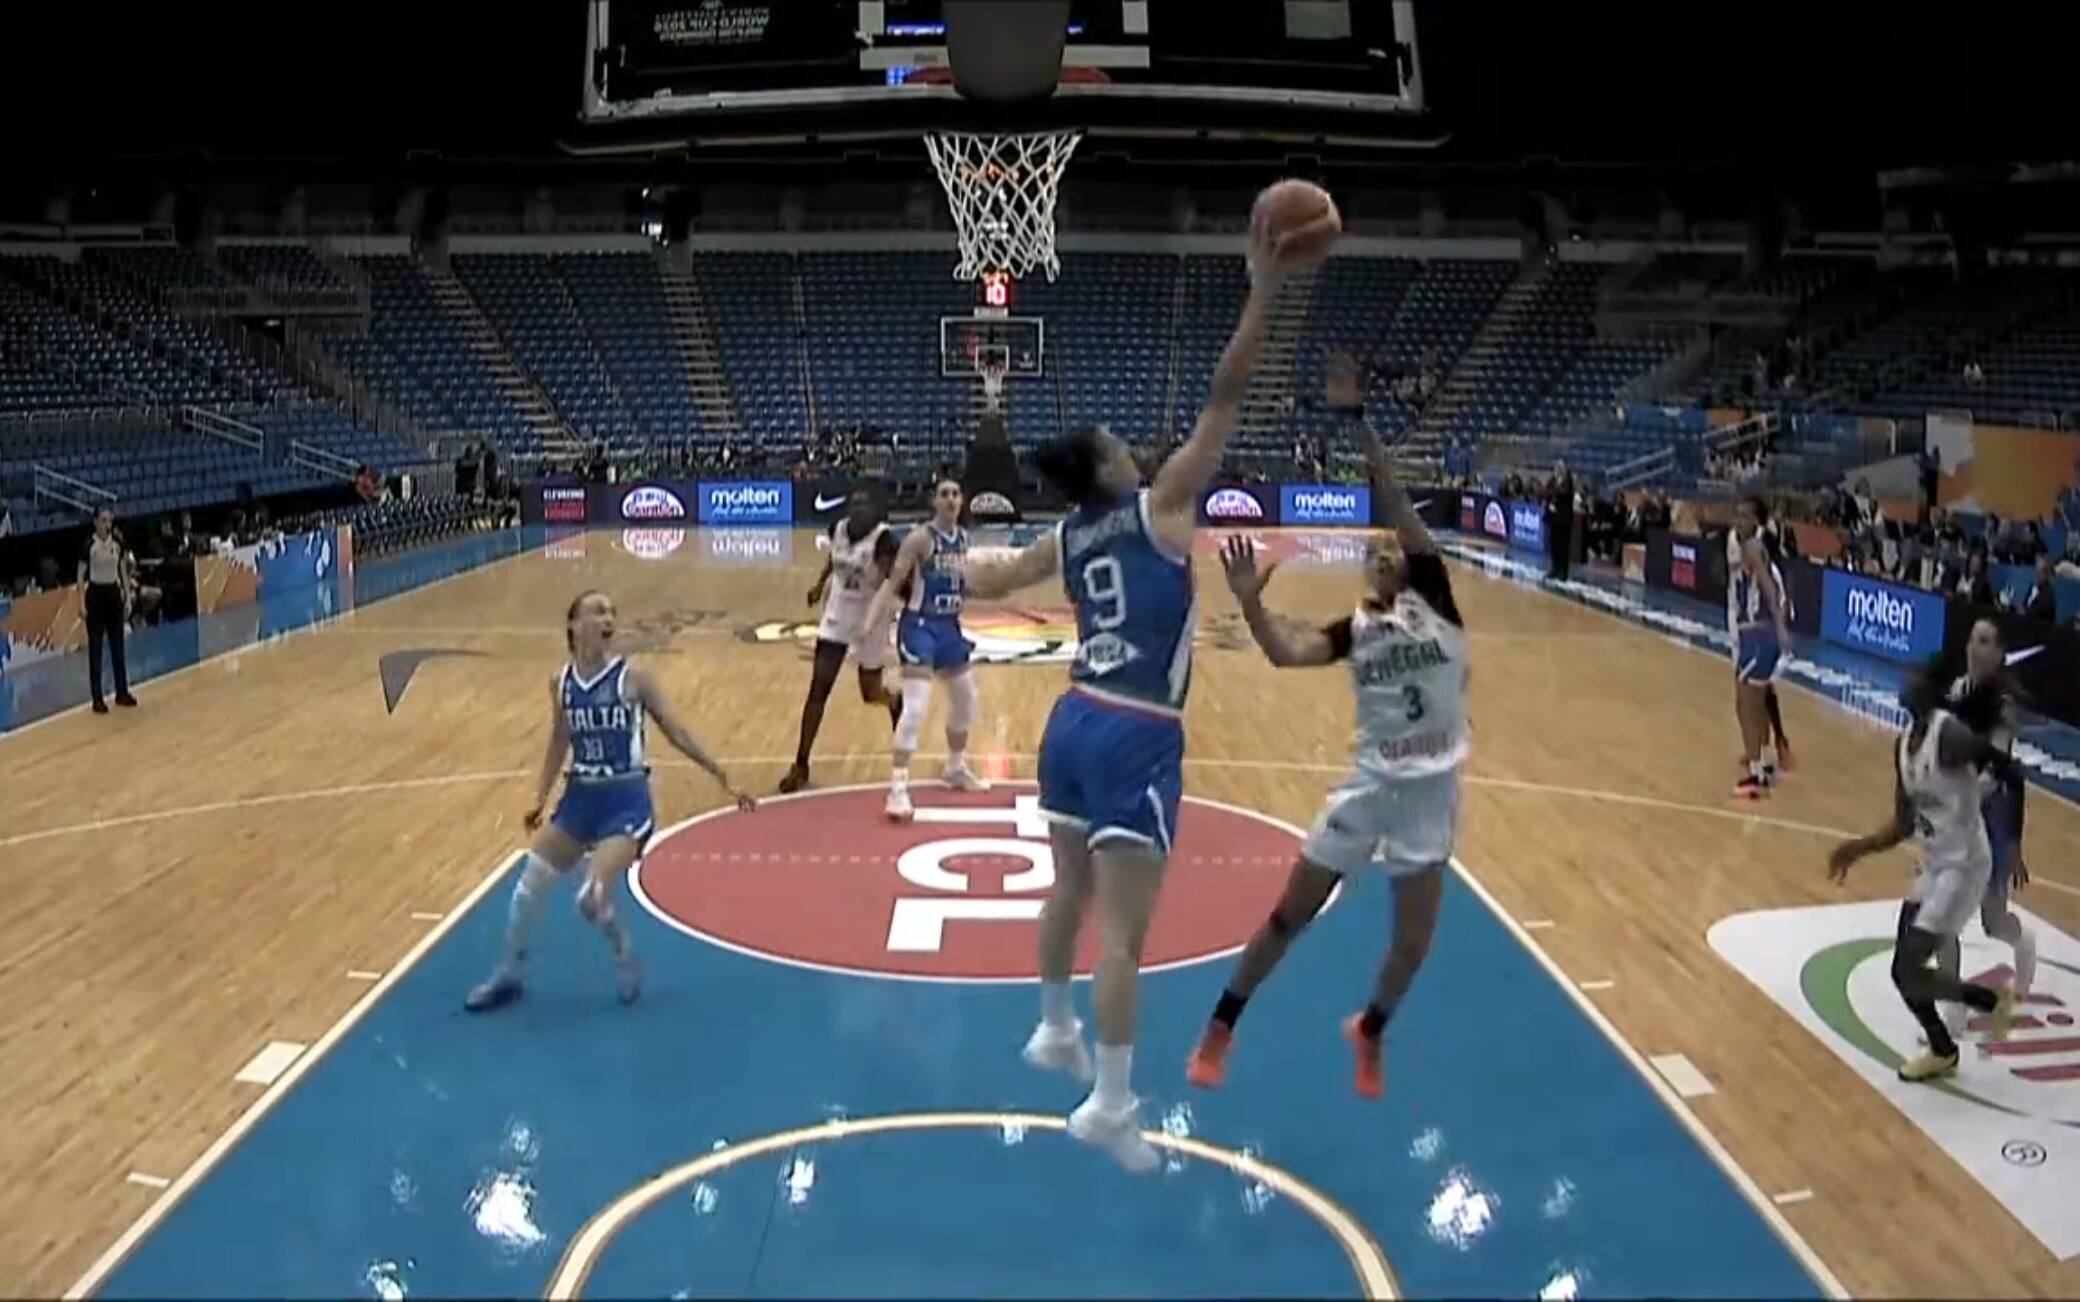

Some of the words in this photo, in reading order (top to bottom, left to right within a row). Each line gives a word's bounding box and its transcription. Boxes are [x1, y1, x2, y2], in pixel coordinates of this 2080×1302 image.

[710, 485, 780, 506] molten
[1294, 489, 1356, 510] molten
[1082, 555, 1127, 629] 9
[1847, 587, 1914, 633] molten
[1402, 684, 1425, 723] 3
[886, 794, 1056, 953] TCL
